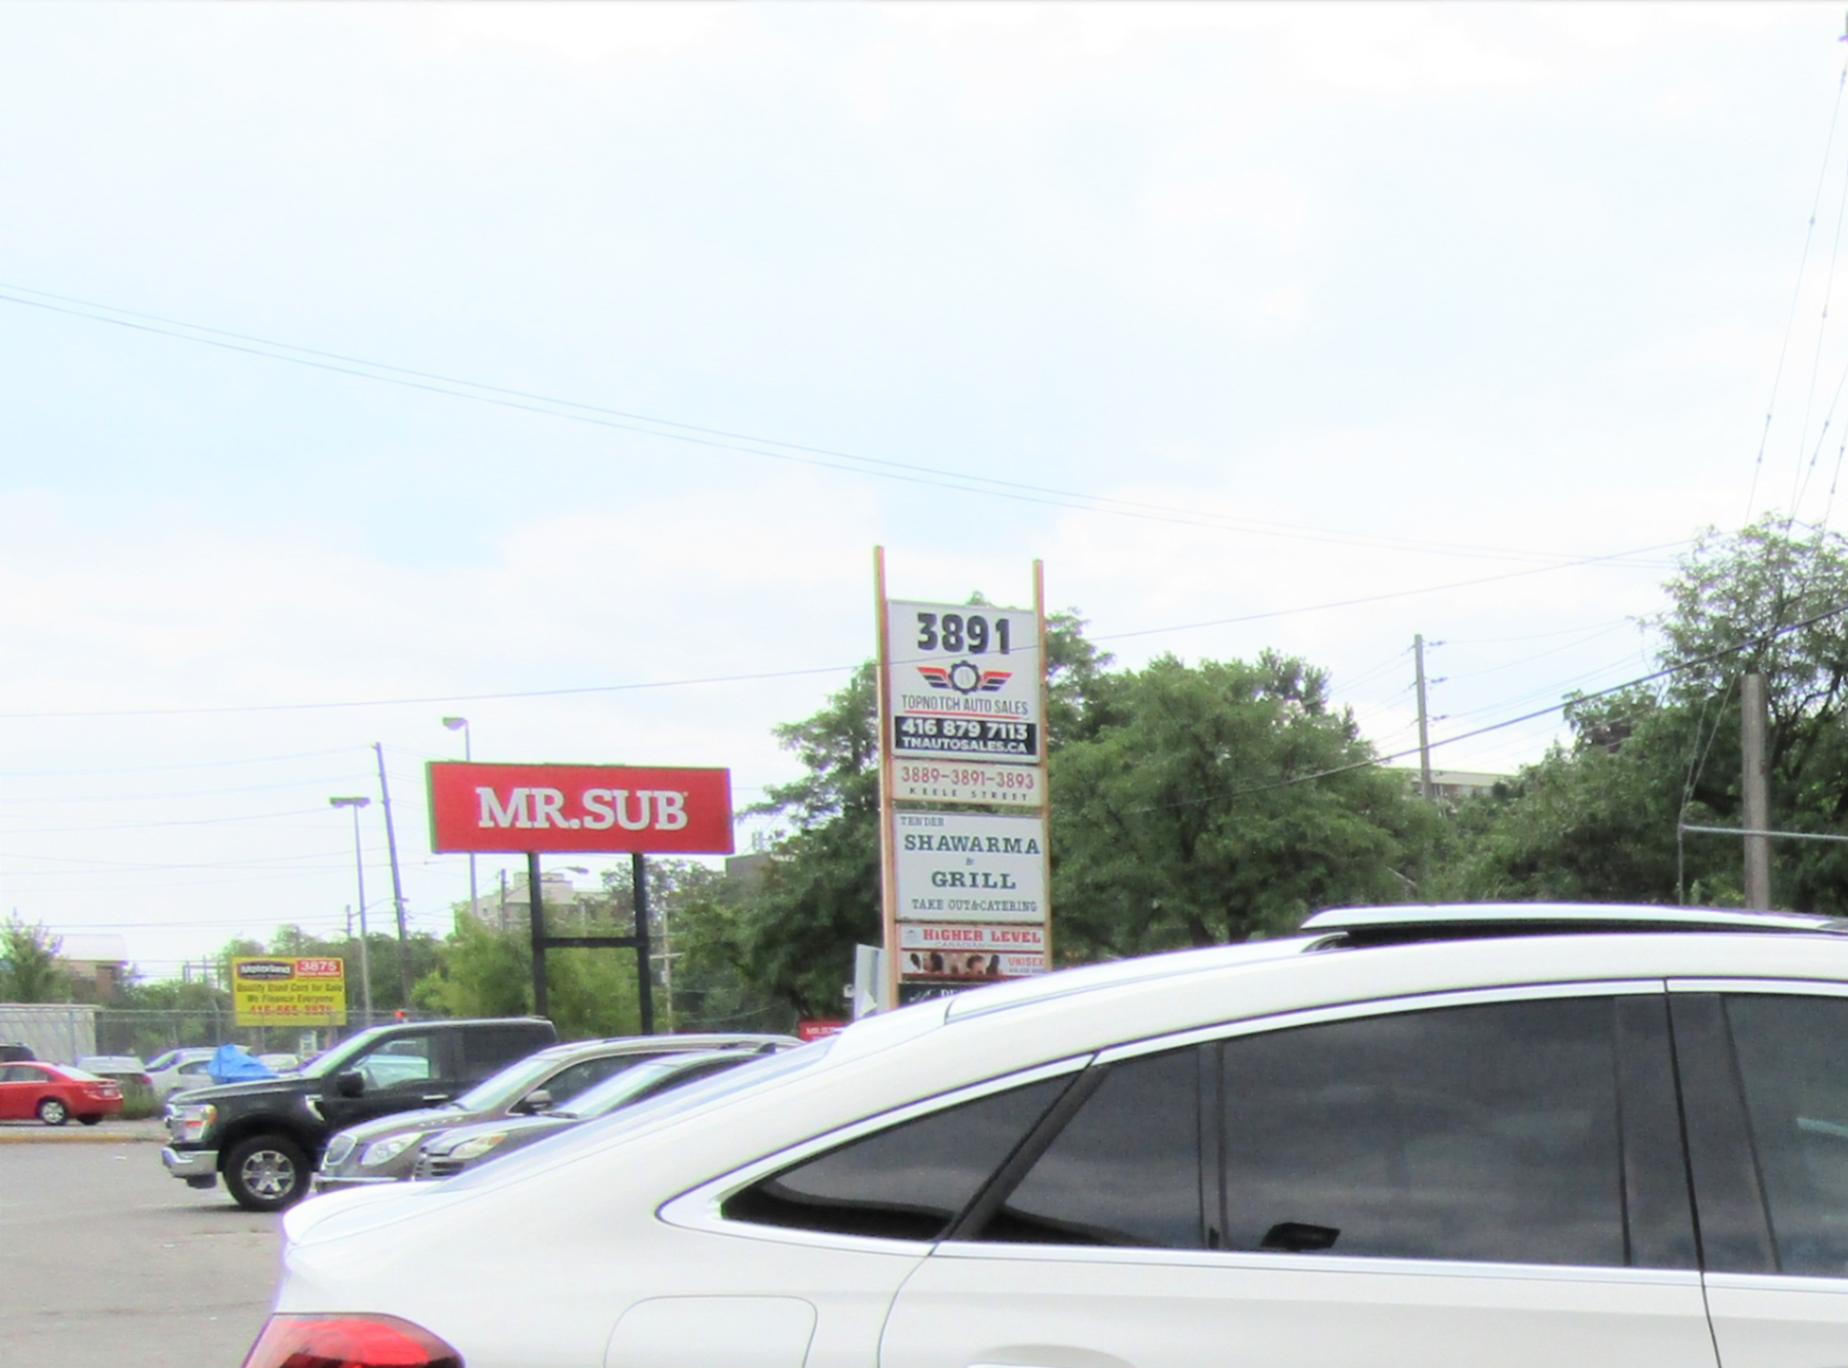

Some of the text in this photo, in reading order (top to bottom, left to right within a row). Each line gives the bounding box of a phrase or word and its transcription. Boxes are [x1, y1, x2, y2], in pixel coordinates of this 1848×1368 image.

[916, 612, 1010, 655] 3891
[901, 694, 1028, 716] TOPNOTCH AUTO SALES
[901, 718, 1028, 741] 416 879 7113
[903, 736, 1027, 754] TNAUTOSALES.CA
[902, 766, 1035, 790] 3889-3891-3893
[909, 787, 1028, 801] KEELE STREET
[475, 787, 689, 831] MR.SUB
[904, 834, 1041, 855] SHAWARMA
[931, 871, 1017, 890] GRILL
[912, 898, 944, 911] TAKE
[990, 930, 1042, 944] LEVEL
[301, 960, 337, 972] 3875
